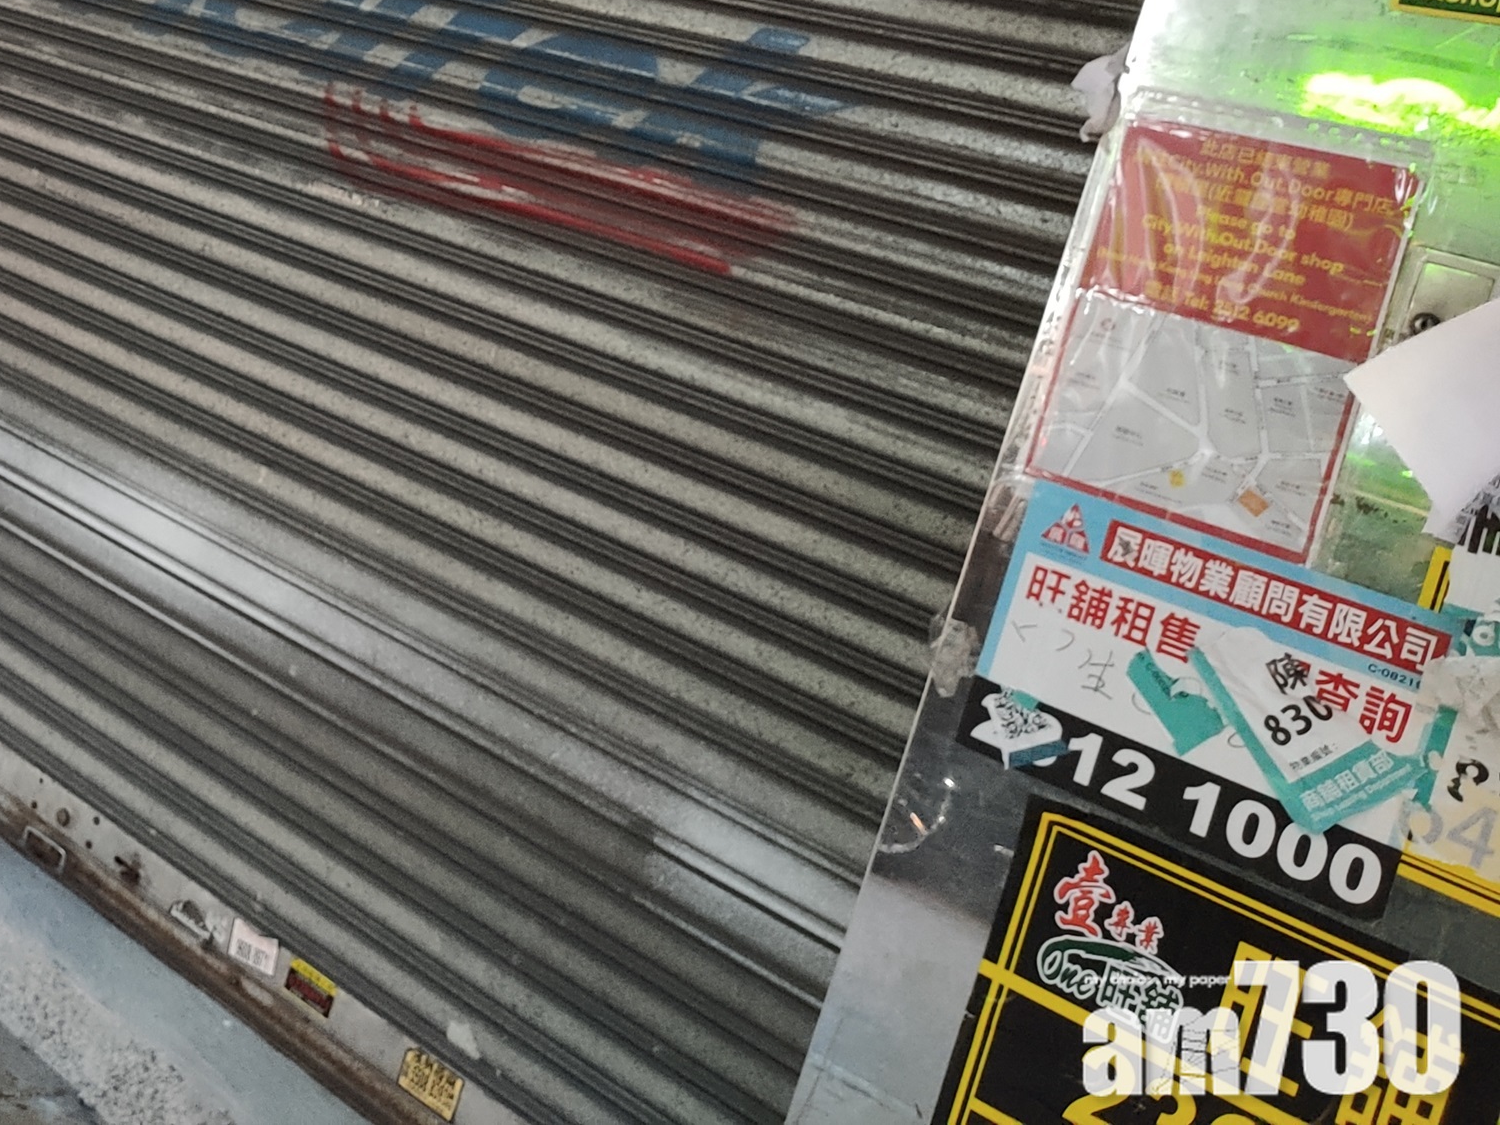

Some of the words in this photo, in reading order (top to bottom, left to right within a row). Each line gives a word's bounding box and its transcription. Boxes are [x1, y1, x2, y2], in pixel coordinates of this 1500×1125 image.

[1284, 225, 1296, 241] to
[1302, 253, 1345, 275] shop
[1253, 307, 1301, 331] 6099
[1183, 780, 1382, 905] 1000
